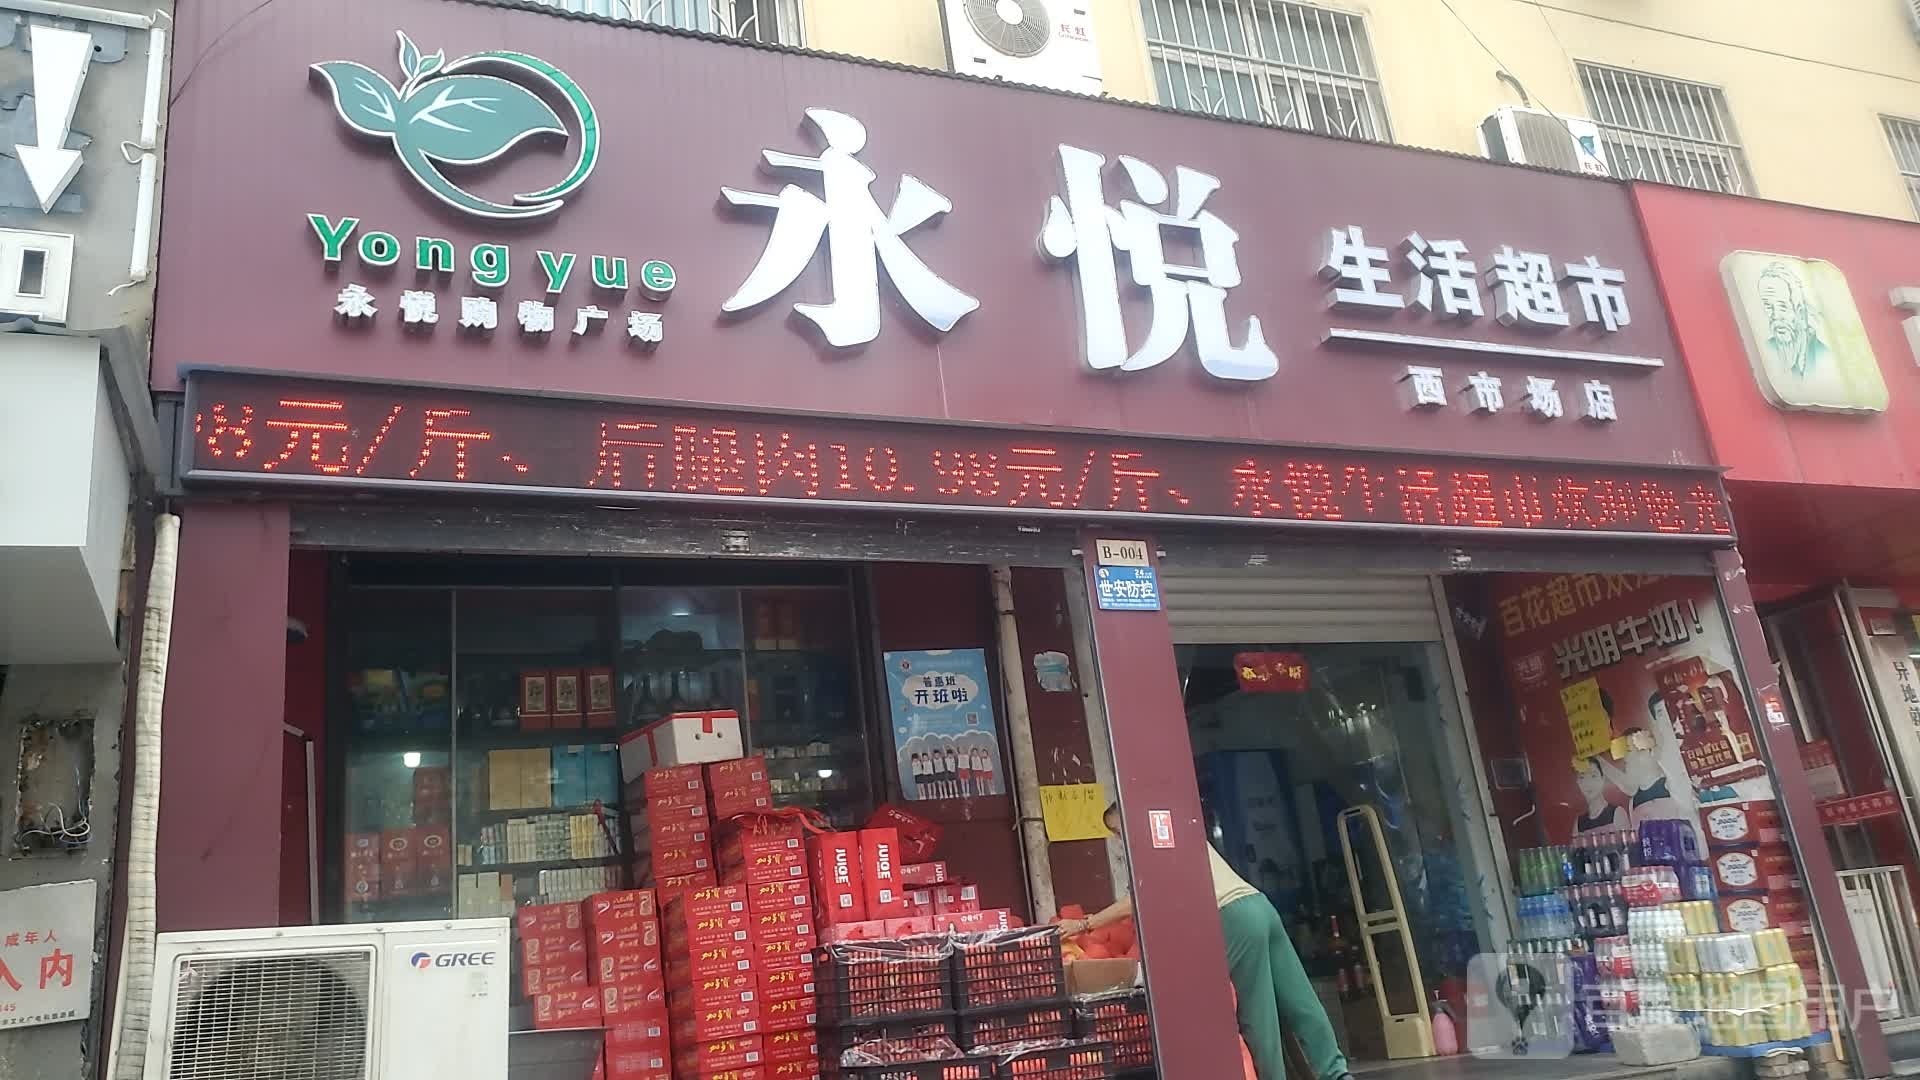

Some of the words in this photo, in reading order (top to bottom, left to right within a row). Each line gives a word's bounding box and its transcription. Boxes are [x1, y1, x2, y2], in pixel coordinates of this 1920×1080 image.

[720, 107, 1279, 381] 永悦
[307, 213, 510, 287] Yong
[536, 250, 677, 298] yue
[1319, 225, 1632, 333] 生活超市
[334, 284, 664, 343] 永悦购物广场
[1403, 365, 1618, 422] 西市场店
[1102, 546, 1143, 560] B-004
[1100, 579, 1156, 598] 世安防控
[923, 676, 957, 688] 普惠班
[915, 688, 969, 704] 开班啦
[694, 887, 721, 900] 加多宝
[697, 917, 725, 930] 加多宝
[760, 911, 787, 925] 加多宝
[701, 947, 728, 960] 加多宝
[764, 940, 792, 953] 加多宝
[435, 951, 496, 968] GREE
[703, 976, 731, 990] 加多宝
[768, 970, 796, 983] 加多宝
[705, 1008, 734, 1022] 加多宝
